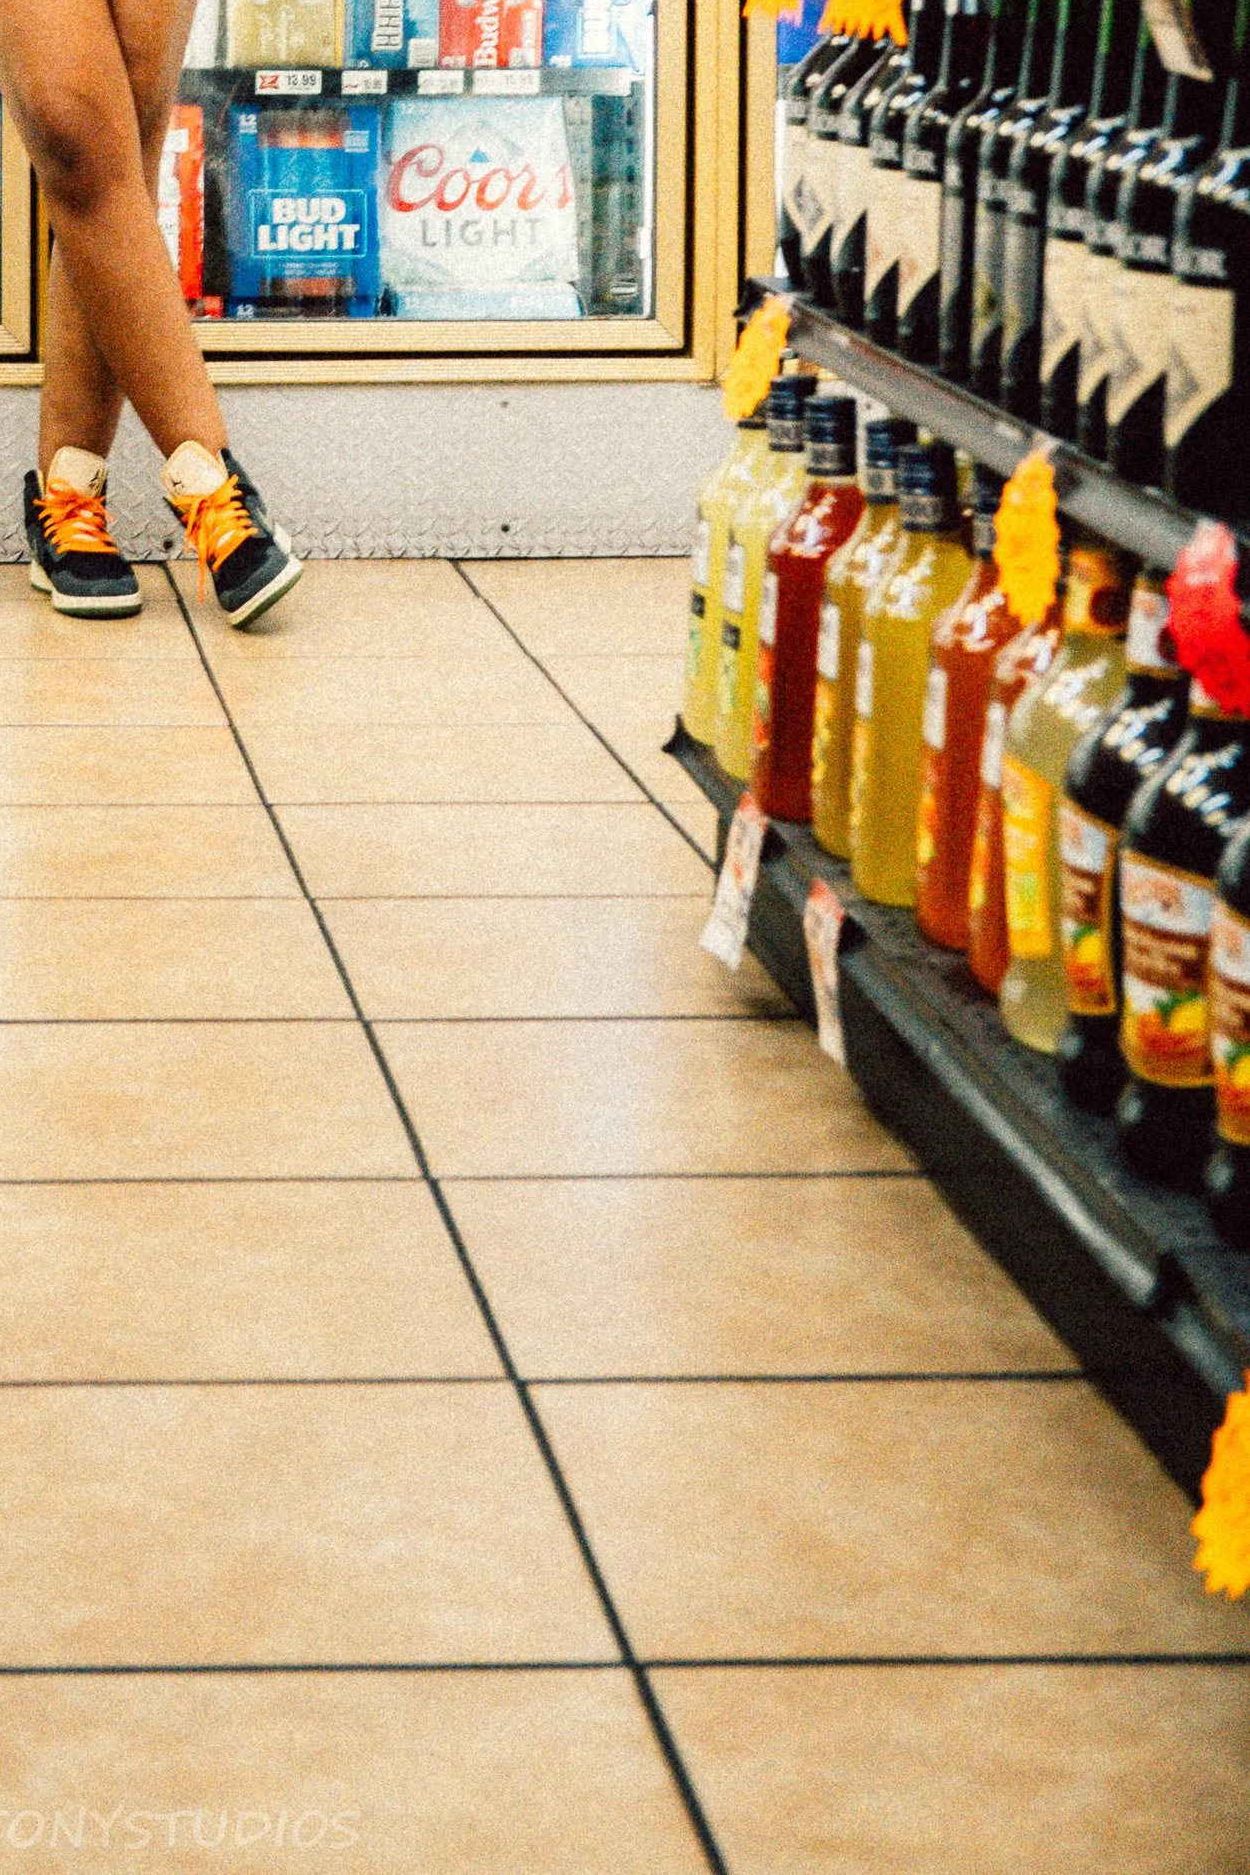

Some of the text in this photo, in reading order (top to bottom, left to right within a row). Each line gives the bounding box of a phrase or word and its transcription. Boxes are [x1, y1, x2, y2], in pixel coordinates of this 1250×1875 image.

[238, 113, 258, 126] 12
[271, 197, 347, 224] BUD
[256, 224, 361, 252] LIGHT
[421, 216, 541, 248] LIGHT
